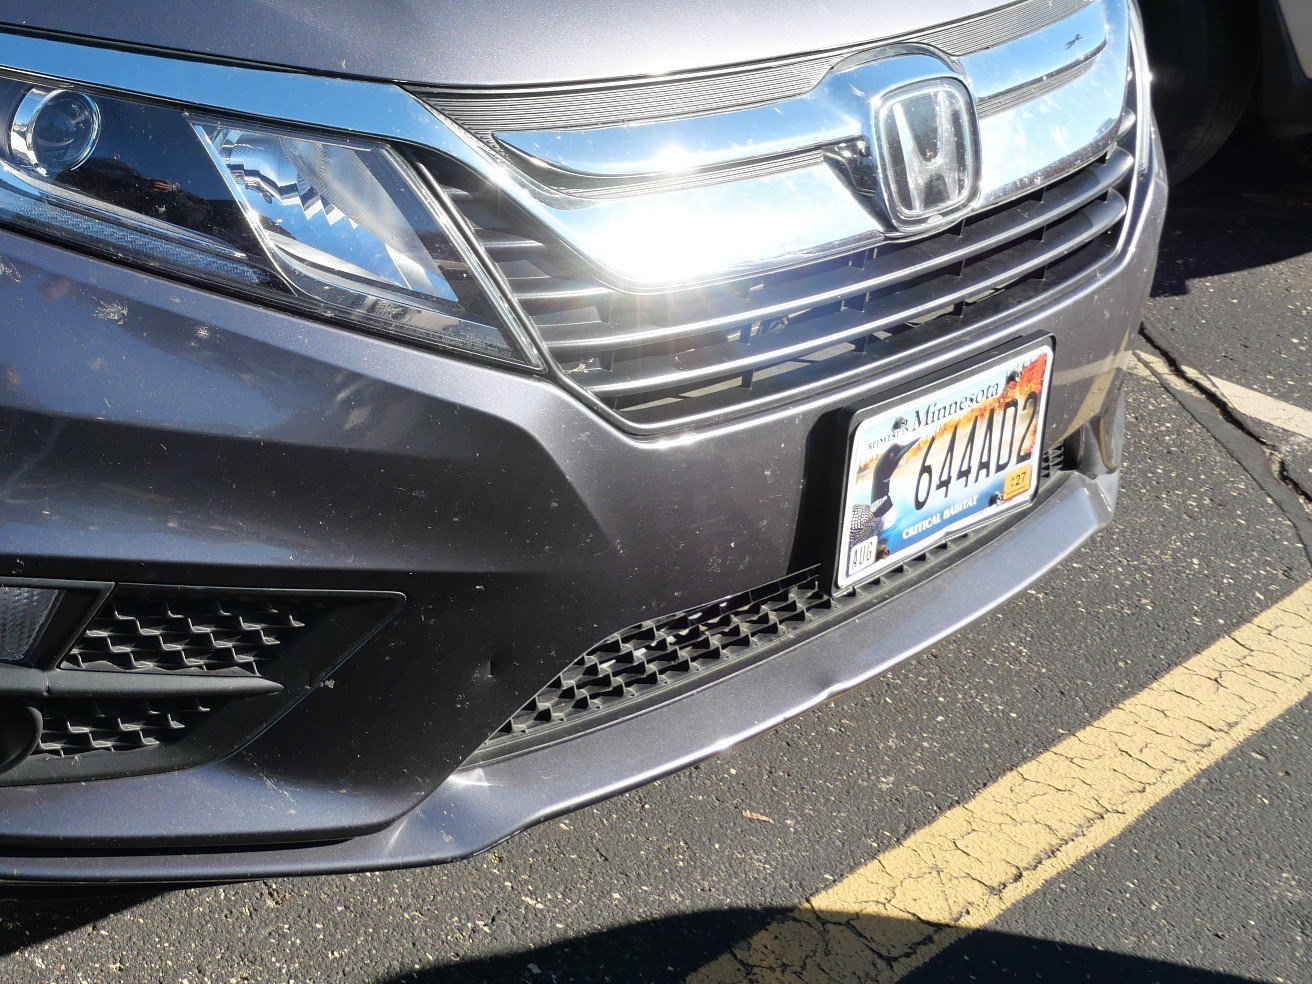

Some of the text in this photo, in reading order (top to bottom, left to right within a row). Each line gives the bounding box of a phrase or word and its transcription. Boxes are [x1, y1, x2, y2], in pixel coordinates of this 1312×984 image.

[911, 382, 1000, 432] Minnesota
[914, 391, 1039, 511] 644AD2
[902, 495, 979, 540] CRITICAL HABITAT
[852, 540, 874, 569] AUG
